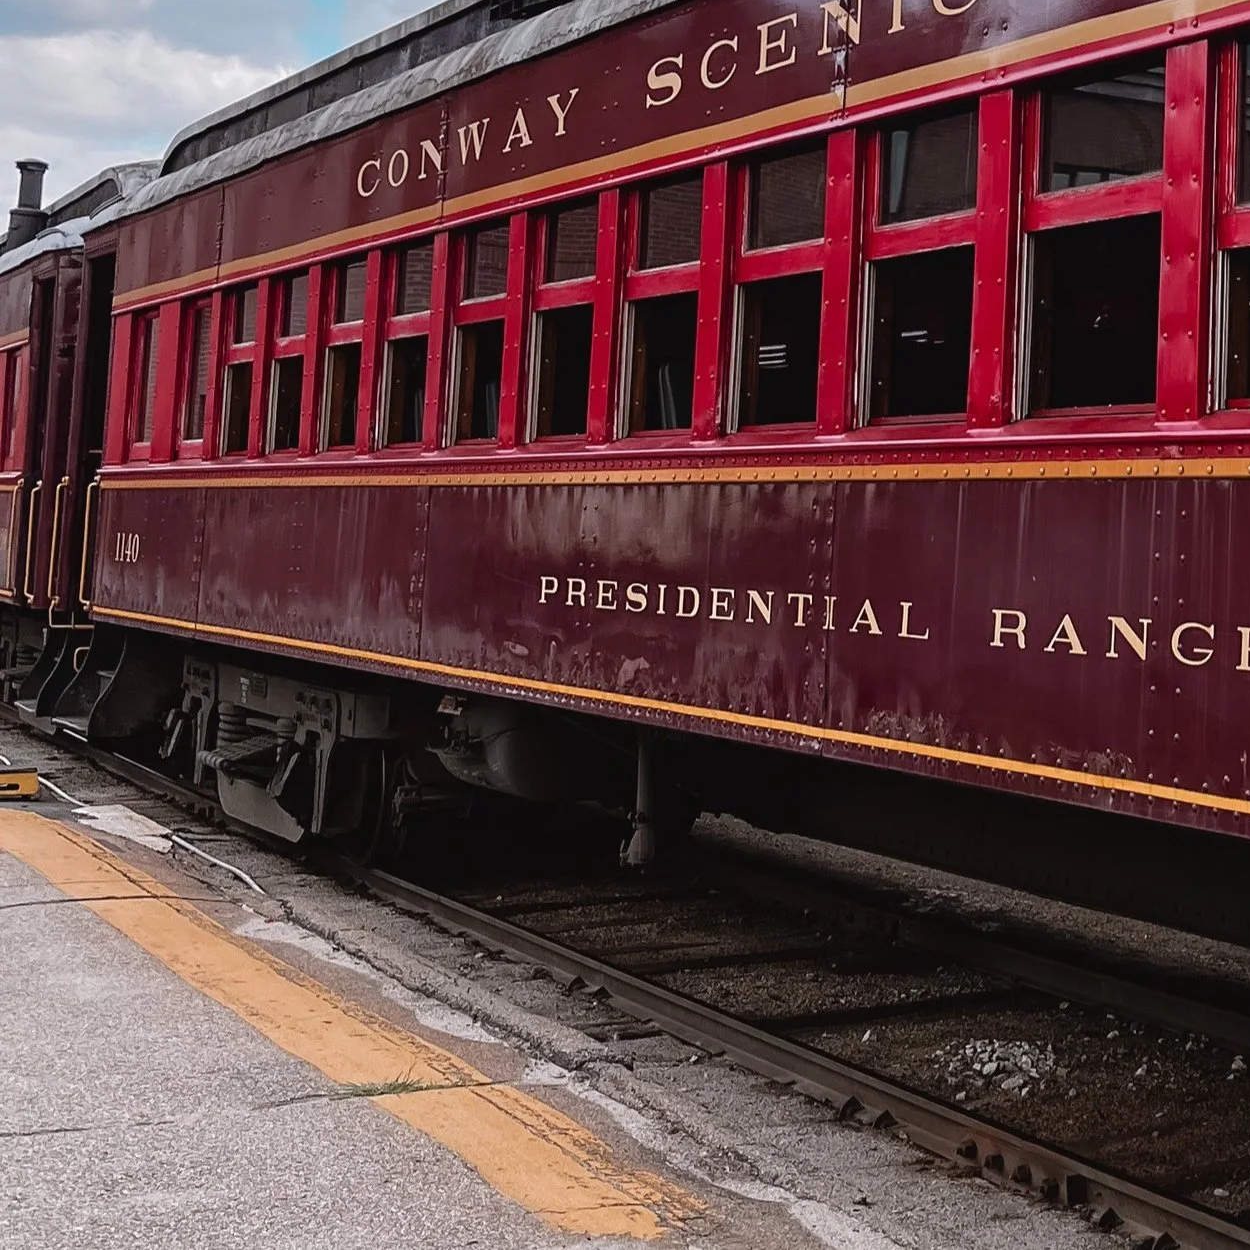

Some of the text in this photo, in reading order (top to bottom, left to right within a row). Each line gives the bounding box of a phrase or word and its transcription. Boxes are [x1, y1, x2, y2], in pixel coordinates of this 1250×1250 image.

[356, 87, 580, 198] CONWAY
[114, 532, 140, 563] 1140
[537, 575, 930, 641] PRESIDENTIAL
